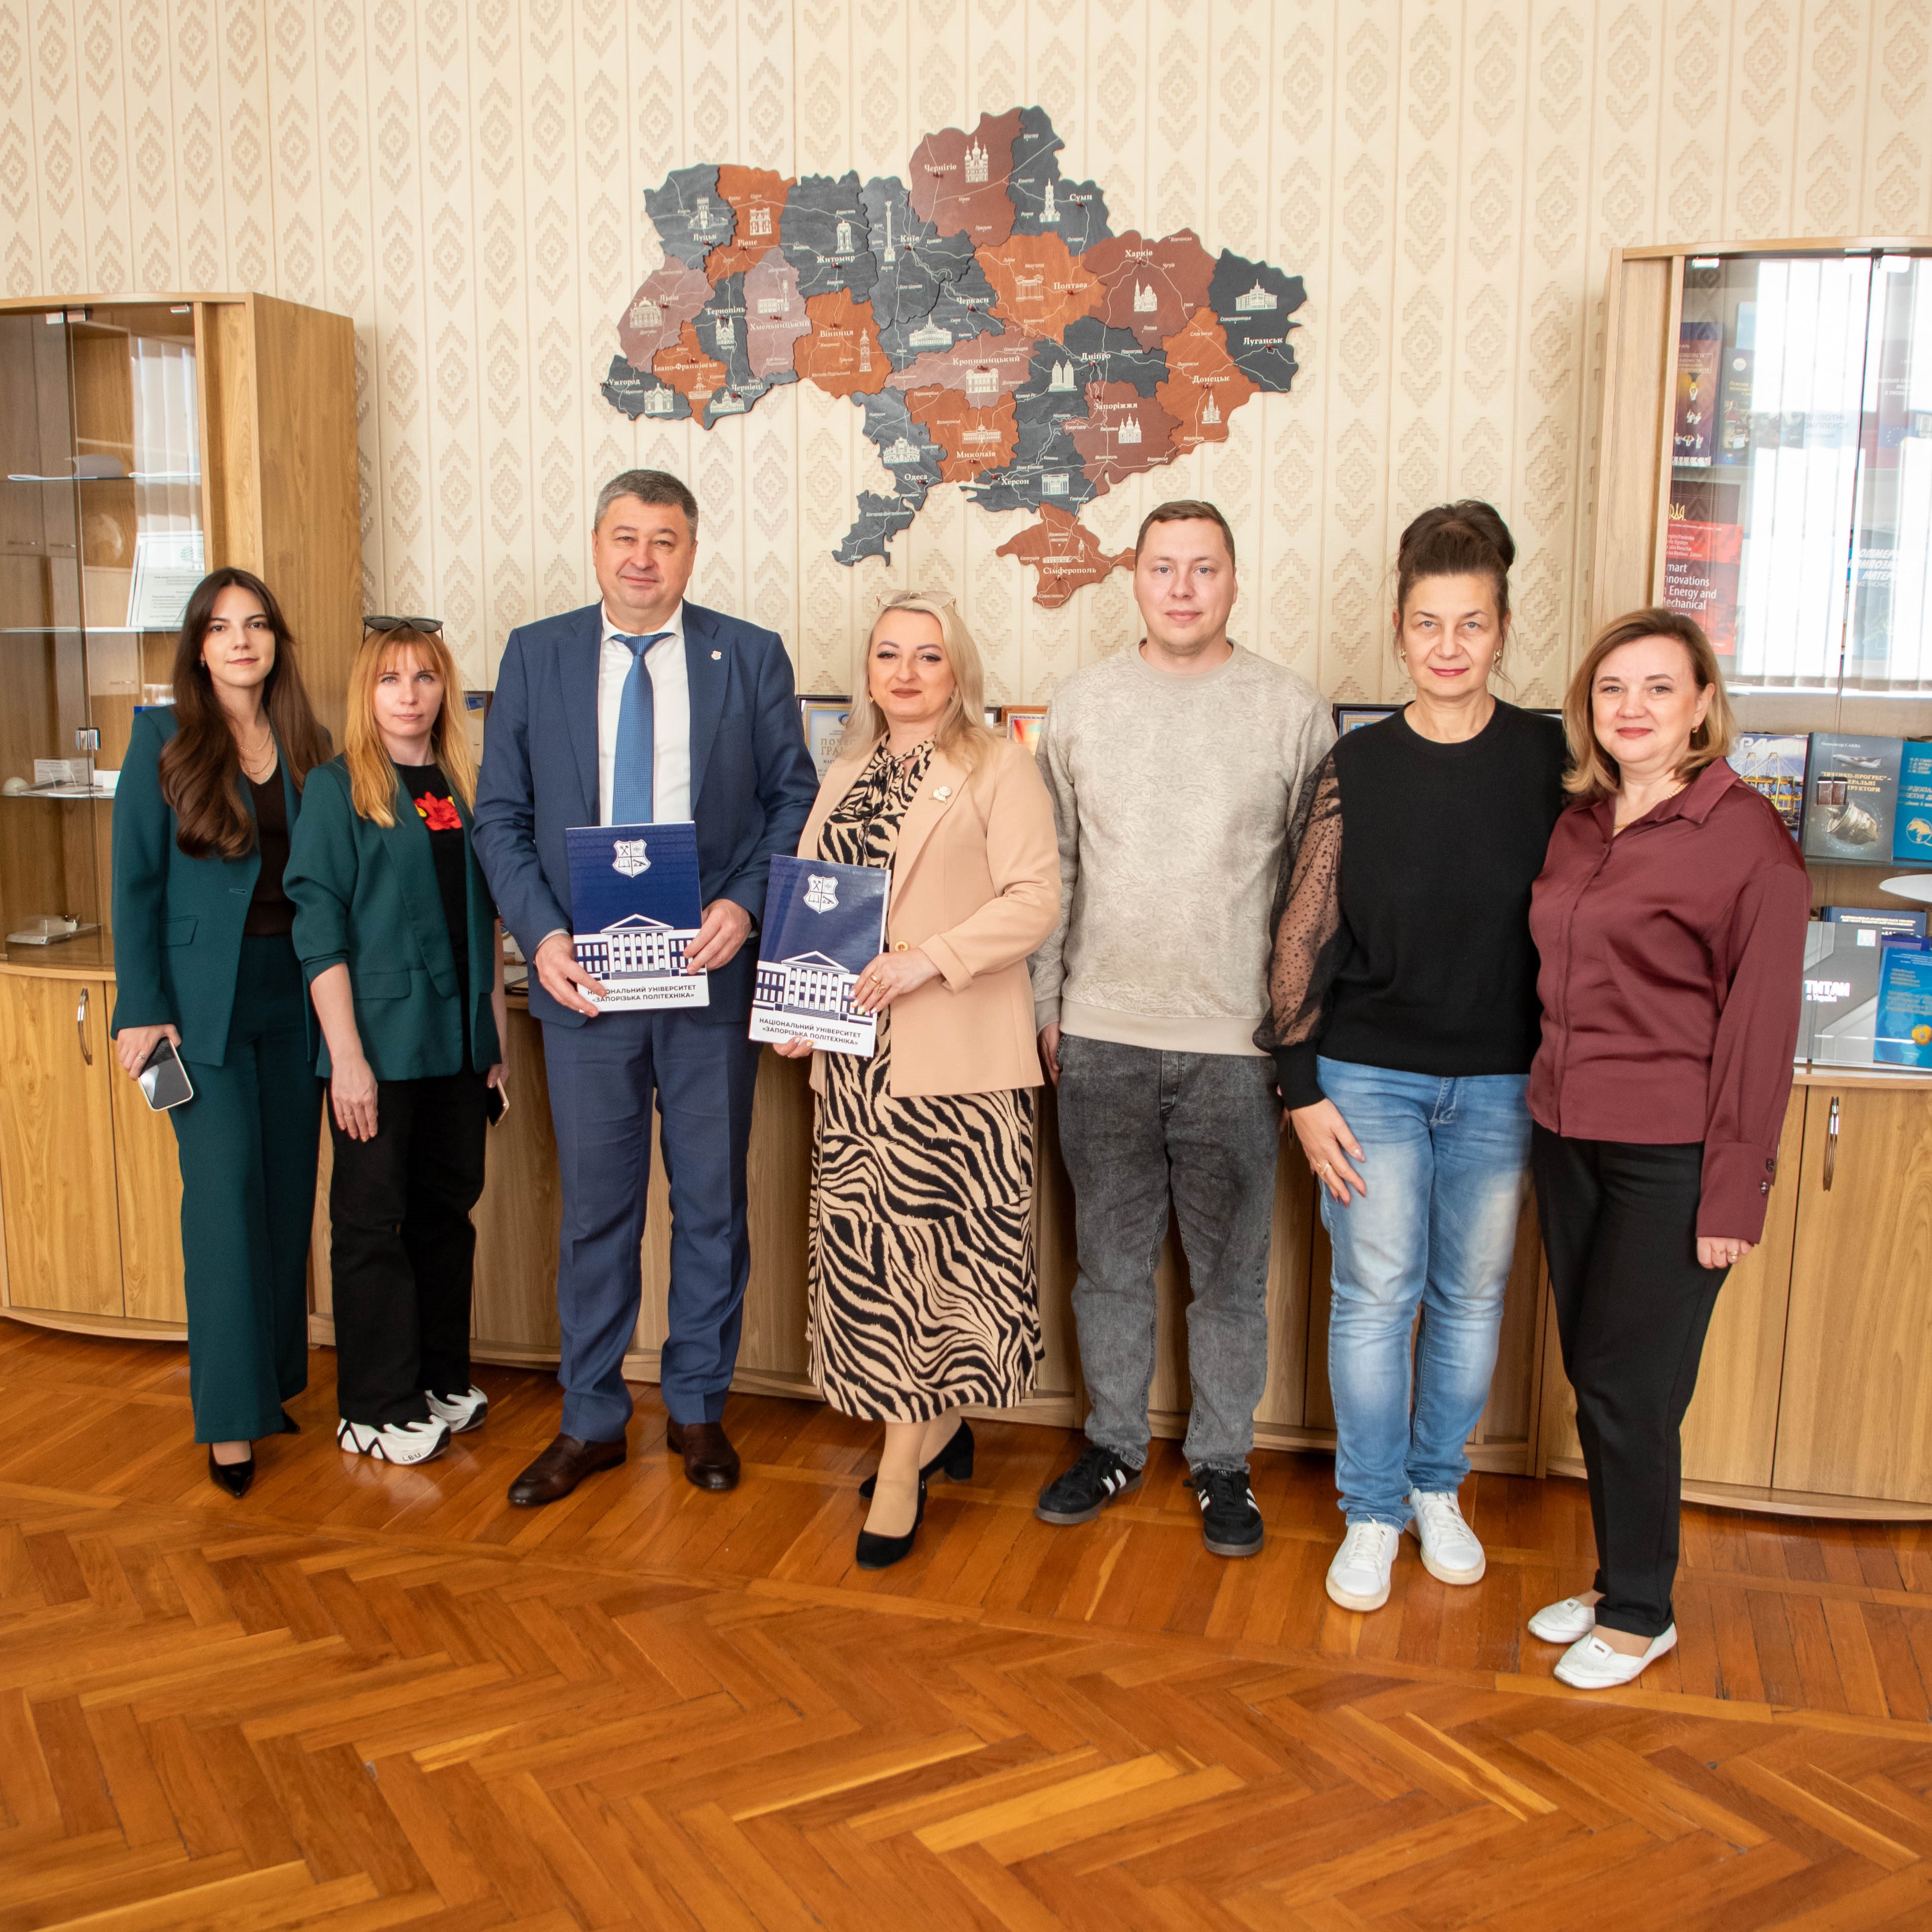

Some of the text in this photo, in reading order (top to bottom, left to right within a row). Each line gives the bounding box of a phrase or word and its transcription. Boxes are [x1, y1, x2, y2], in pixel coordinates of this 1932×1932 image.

[924, 164, 957, 173] Чернігів
[1069, 193, 1092, 202] Суми
[693, 233, 717, 241] Луцьк
[1125, 250, 1153, 258] Харків
[817, 255, 856, 263] Житомир
[956, 297, 989, 306] Черкаси
[705, 307, 745, 315] Тернопіль
[750, 320, 810, 331] Хмельницький
[1243, 337, 1283, 345] Луганськ
[953, 355, 1020, 366] Кропивницький
[1081, 353, 1111, 361] Дніпро
[654, 362, 718, 372] Івано-Франківськ
[1192, 375, 1230, 384] Донецьк
[1093, 402, 1138, 411] Запоріжжя
[956, 451, 996, 459] Миколаїв
[904, 473, 928, 482] Одеса
[1001, 478, 1030, 486] Херсон
[1043, 567, 1097, 575] Сімферополь
[1667, 564, 1688, 573] mart
[1665, 575, 1710, 587] nnovations
[1669, 585, 1699, 599] Energy
[1700, 589, 1717, 599] and
[588, 985, 696, 996] НОНАЛЬНИЙ УНІВЕРСИТЕТ
[759, 1017, 861, 1038] НАЦІОНАЛЬНИЙ УНІВЕРСИТЕТ
[762, 1026, 858, 1045] «ЗАПОРІЗЬКА ПОЛІТЕХНІКА»
